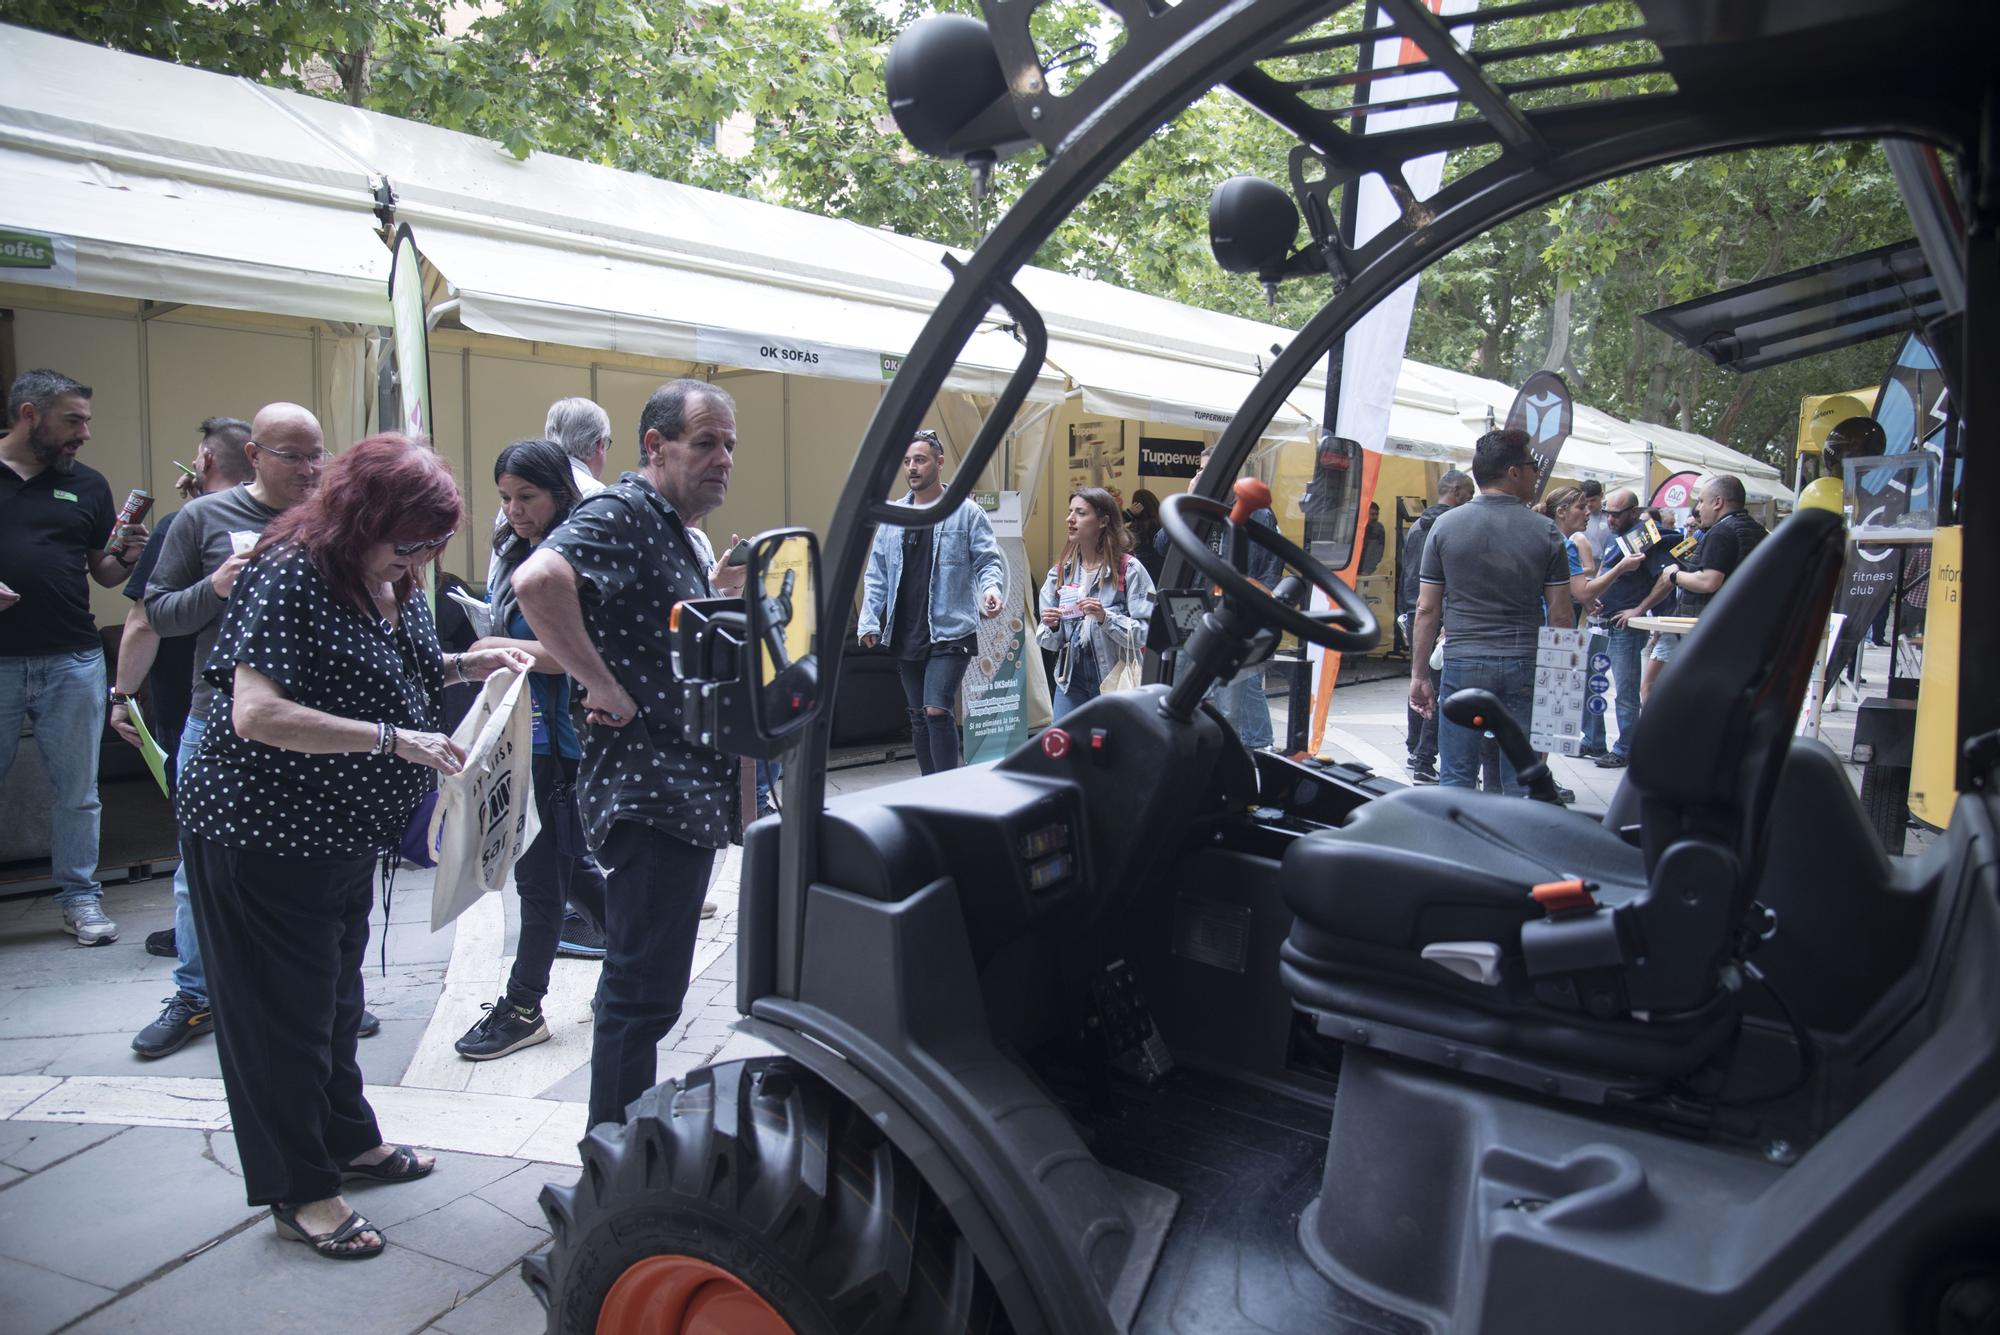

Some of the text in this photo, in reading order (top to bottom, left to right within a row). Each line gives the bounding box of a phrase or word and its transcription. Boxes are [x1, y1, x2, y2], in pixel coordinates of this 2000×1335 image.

[760, 346, 819, 364] OK SOFÁS
[1852, 571, 1894, 582] fitness
[1850, 585, 1874, 596] club
